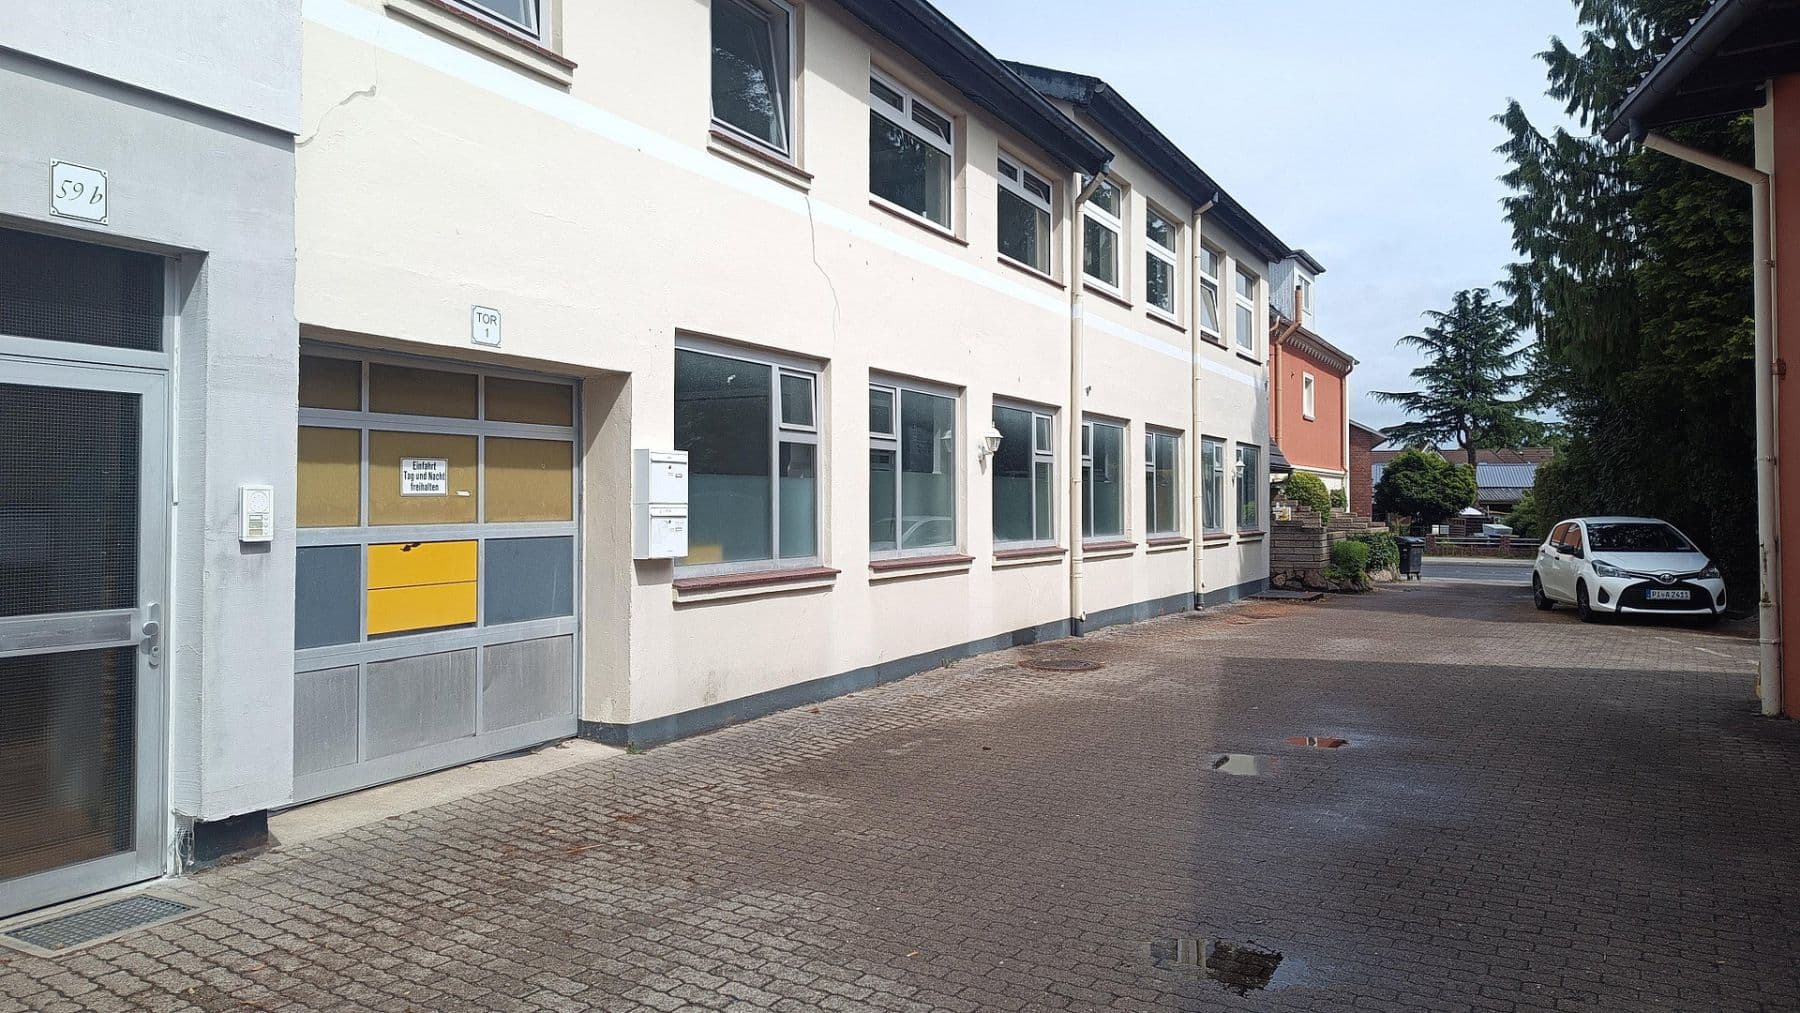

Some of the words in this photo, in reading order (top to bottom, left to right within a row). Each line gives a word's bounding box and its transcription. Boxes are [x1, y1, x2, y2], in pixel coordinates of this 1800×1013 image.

[56, 179, 84, 201] 59
[89, 186, 103, 204] b
[476, 312, 497, 326] TOR
[412, 461, 437, 470] Einfahrt
[403, 471, 414, 481] Tag
[415, 472, 427, 480] und
[428, 472, 445, 481] Nacht
[410, 482, 439, 491] freihalten
